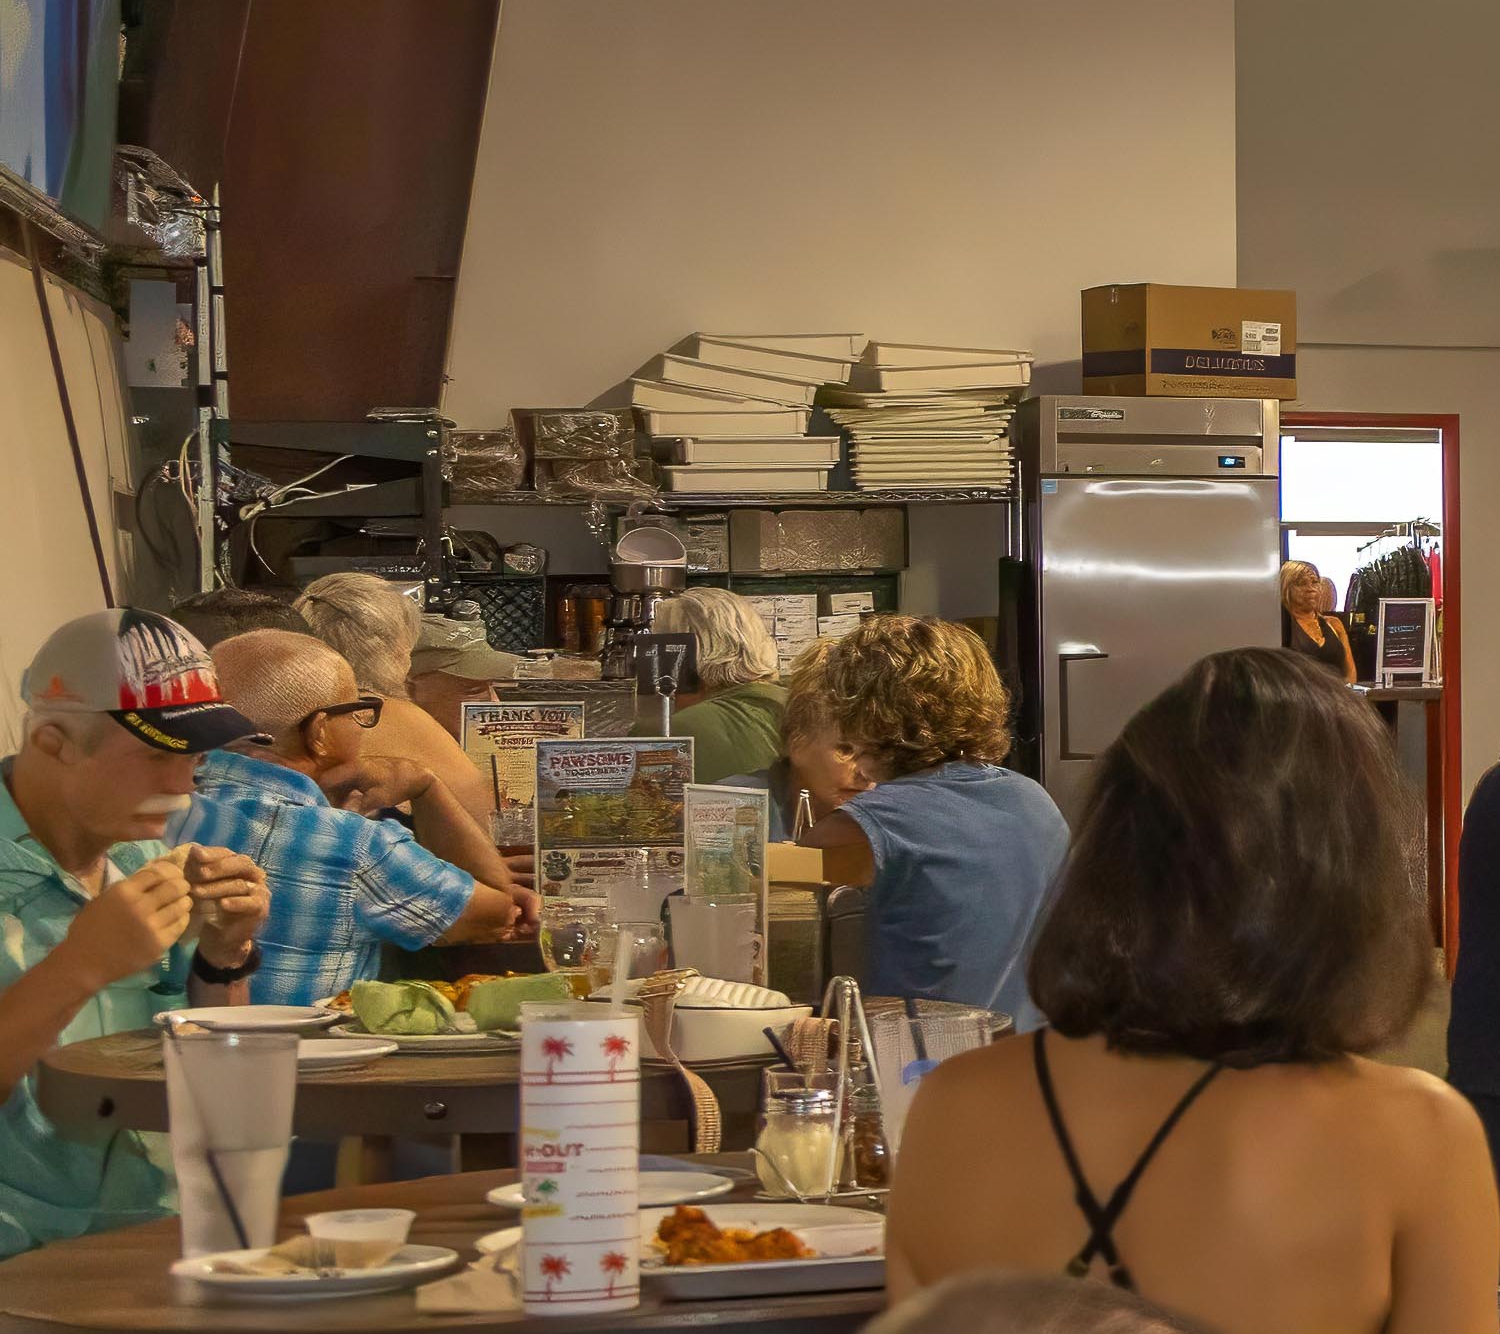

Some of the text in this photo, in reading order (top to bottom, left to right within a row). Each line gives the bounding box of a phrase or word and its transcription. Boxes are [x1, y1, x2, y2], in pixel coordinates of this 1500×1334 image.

[477, 709, 570, 723] THANK YOU
[550, 751, 633, 770] PAWSOME
